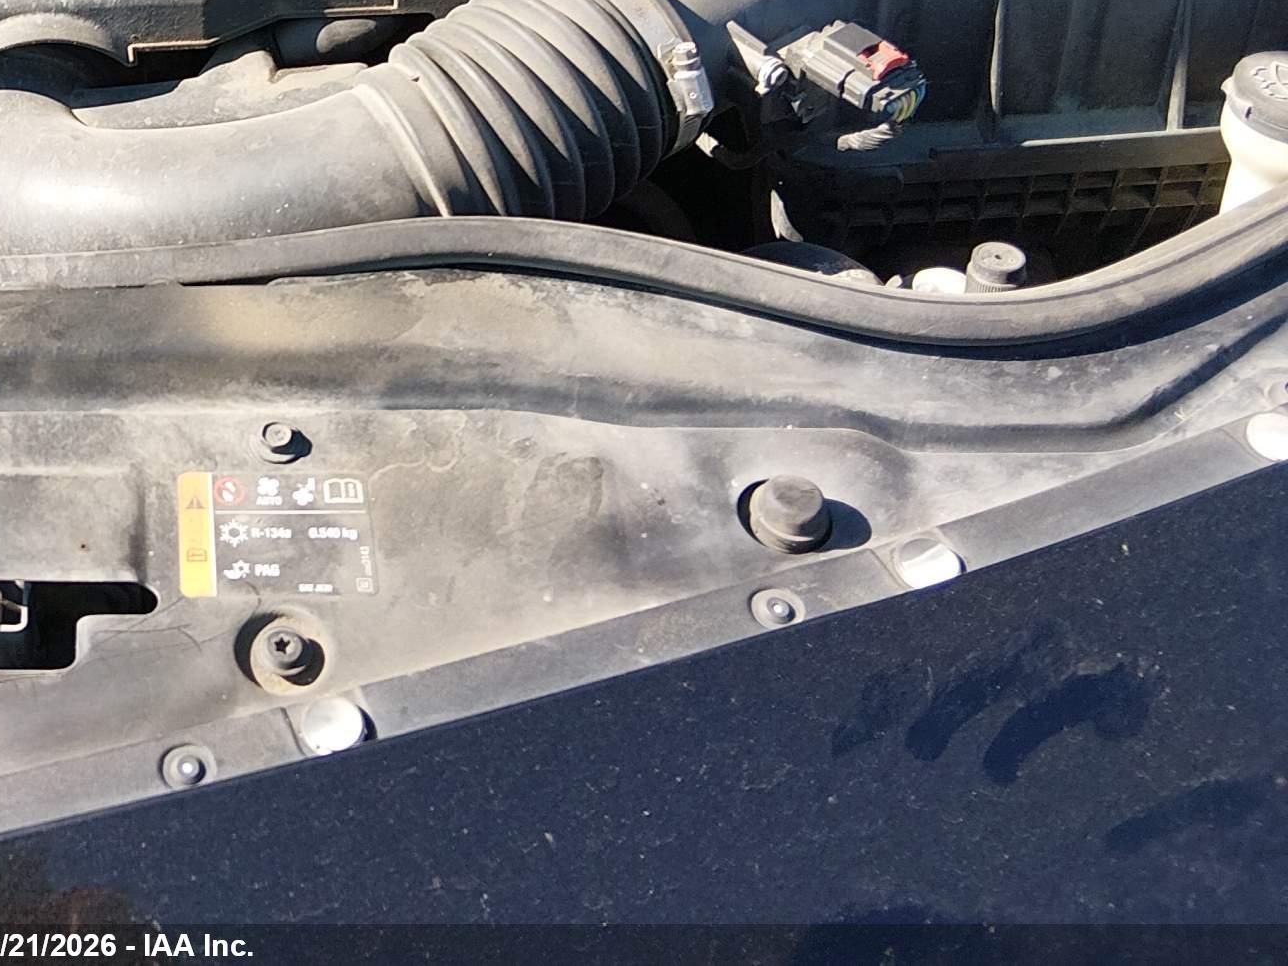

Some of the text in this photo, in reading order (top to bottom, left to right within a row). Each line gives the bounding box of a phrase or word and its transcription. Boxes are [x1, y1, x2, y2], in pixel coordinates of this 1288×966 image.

[250, 527, 292, 539] R-134a
[341, 527, 358, 541] kg
[254, 563, 280, 577] PAG
